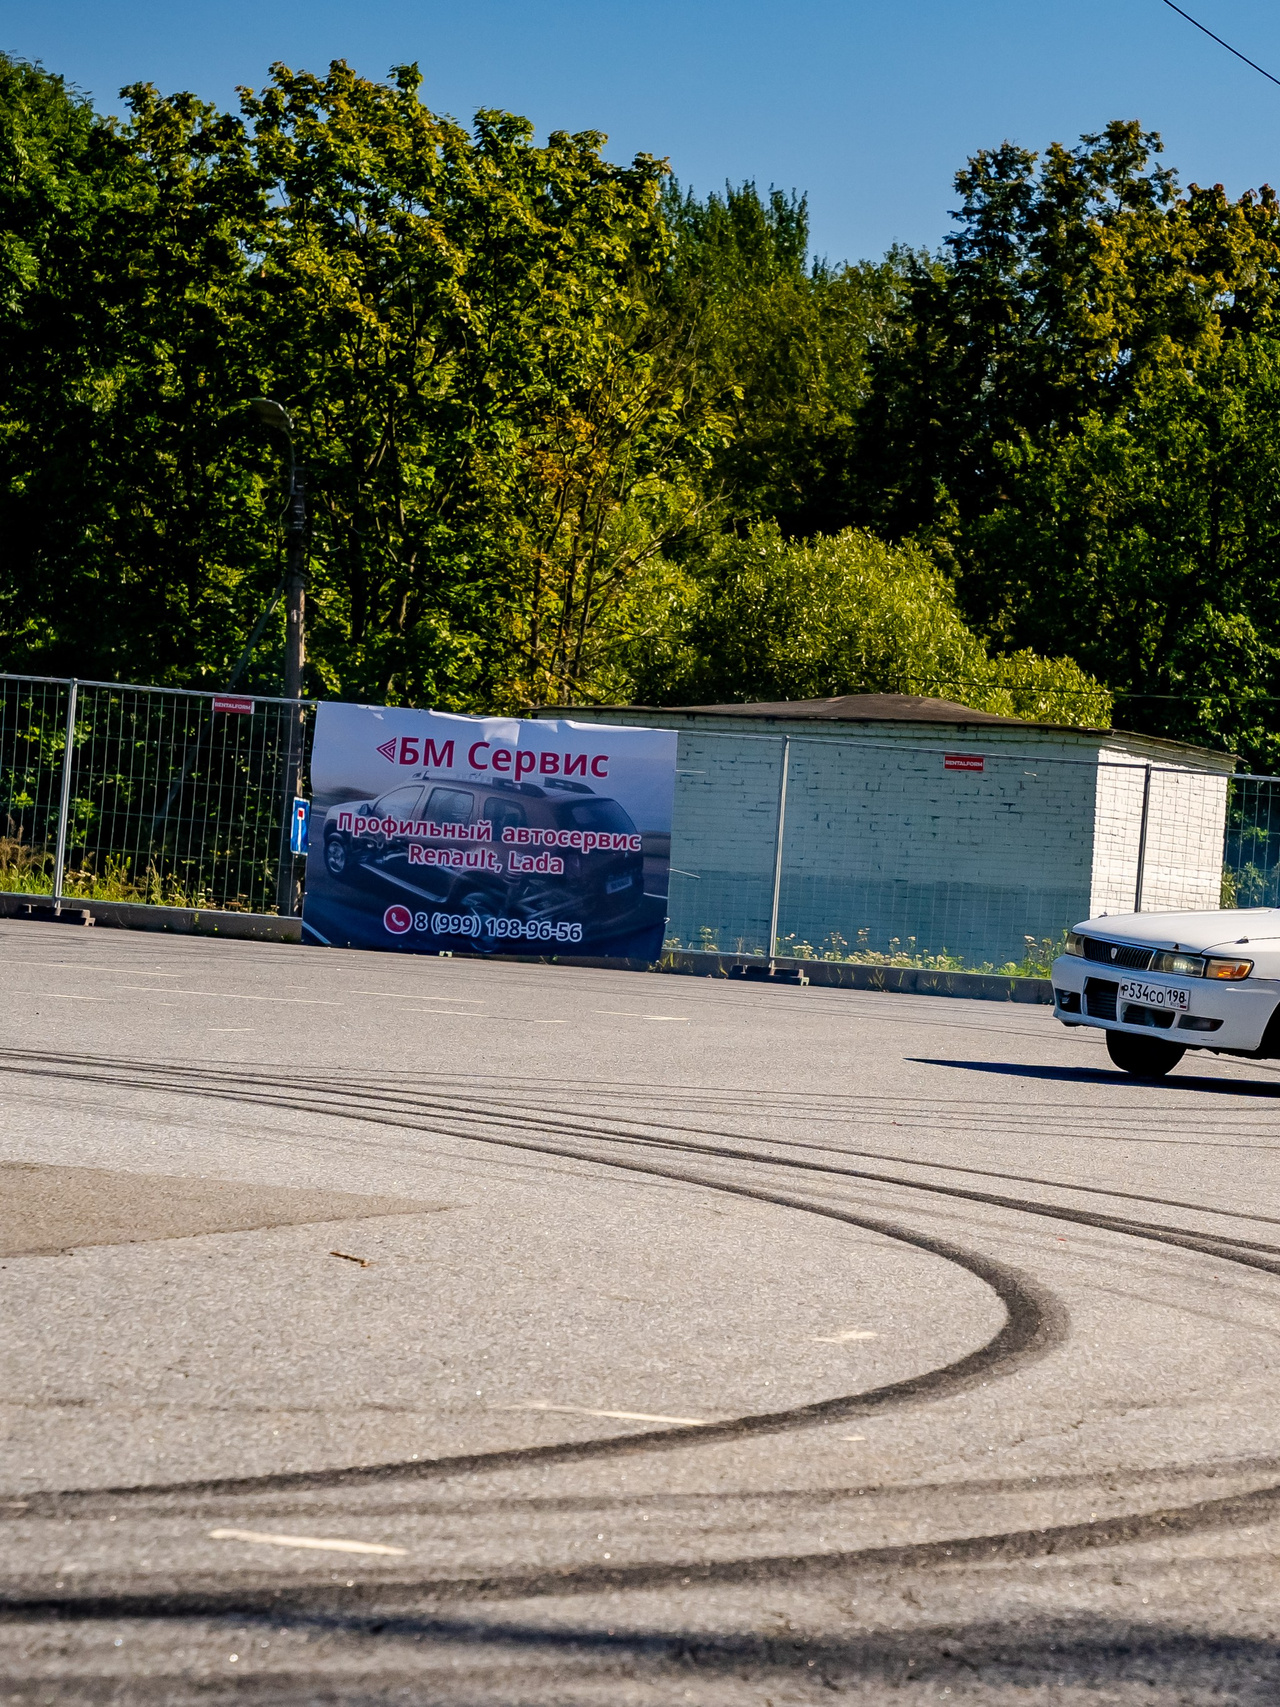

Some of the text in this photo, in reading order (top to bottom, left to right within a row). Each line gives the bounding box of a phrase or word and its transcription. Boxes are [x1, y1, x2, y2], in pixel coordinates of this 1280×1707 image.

[399, 737, 610, 782] БМ Сервис
[336, 812, 642, 852] Профильный автосервис
[408, 844, 565, 875] Renault, Lada
[414, 912, 583, 942] 8 (999) 198-96-56
[1167, 989, 1186, 1003] 198
